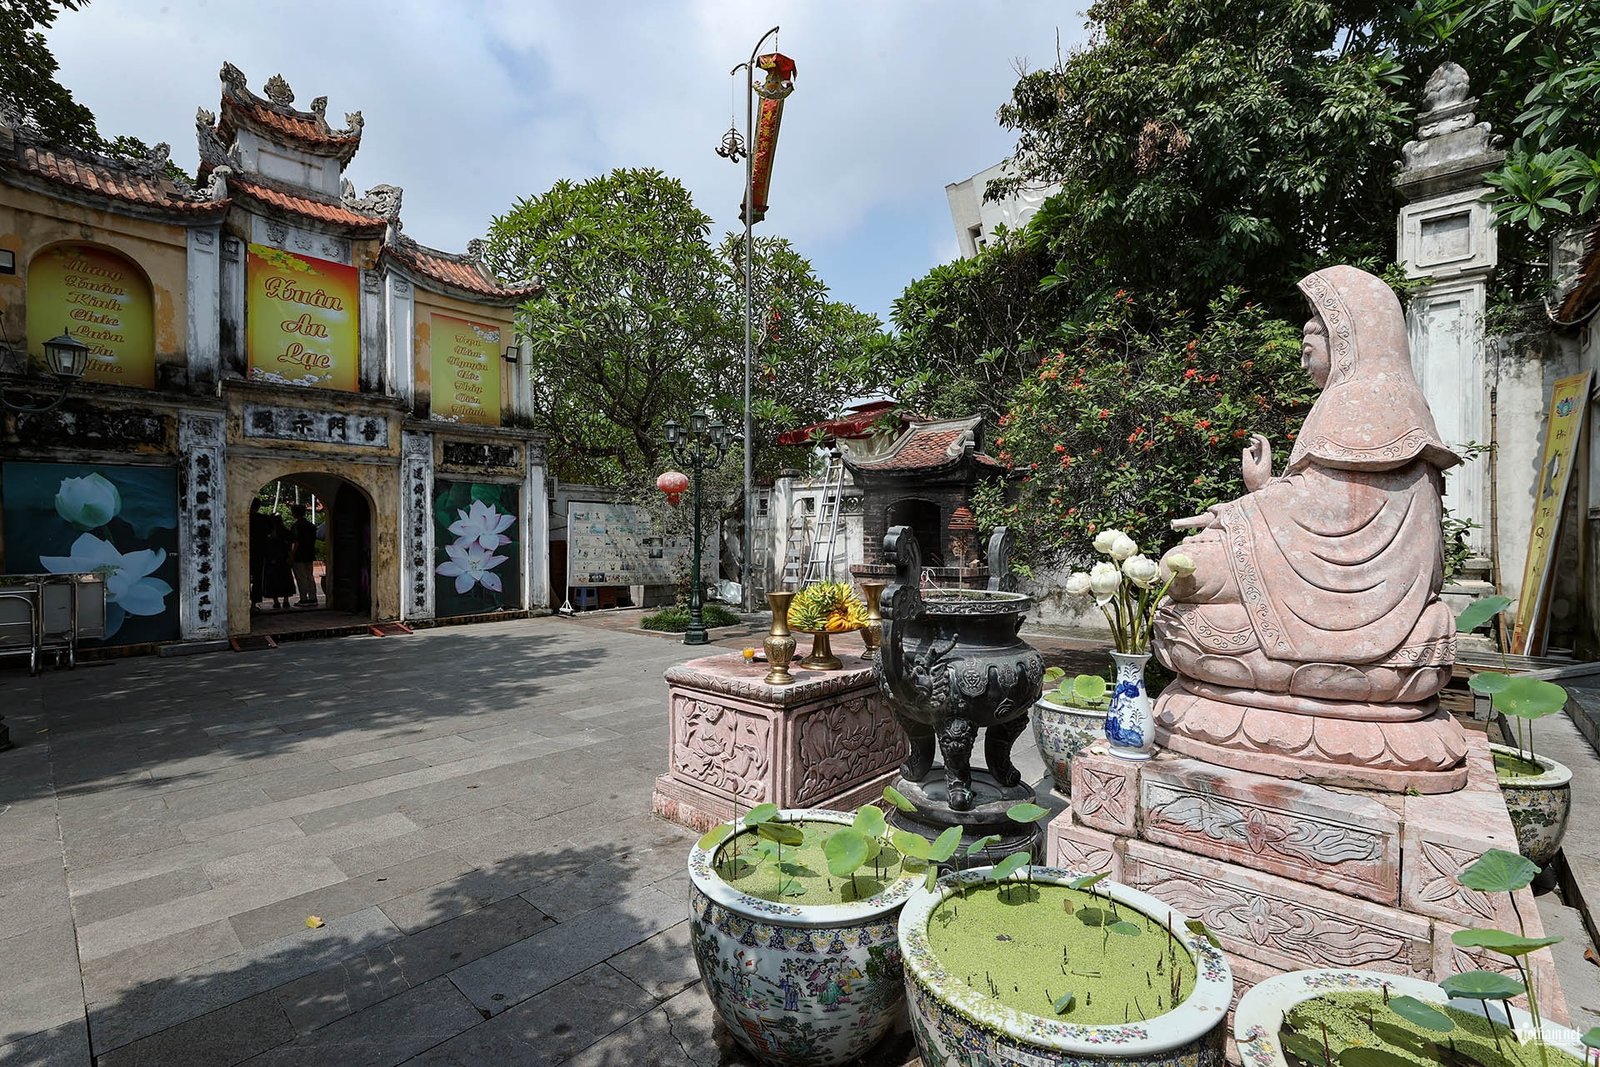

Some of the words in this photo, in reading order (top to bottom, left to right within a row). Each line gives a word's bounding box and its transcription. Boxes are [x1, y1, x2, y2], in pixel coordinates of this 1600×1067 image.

[64, 275, 124, 296] Xuân
[264, 276, 343, 312] Xuân
[66, 291, 123, 311] Kính
[70, 308, 119, 326] Chúc
[280, 313, 328, 339] An
[277, 342, 331, 371] Lạc
